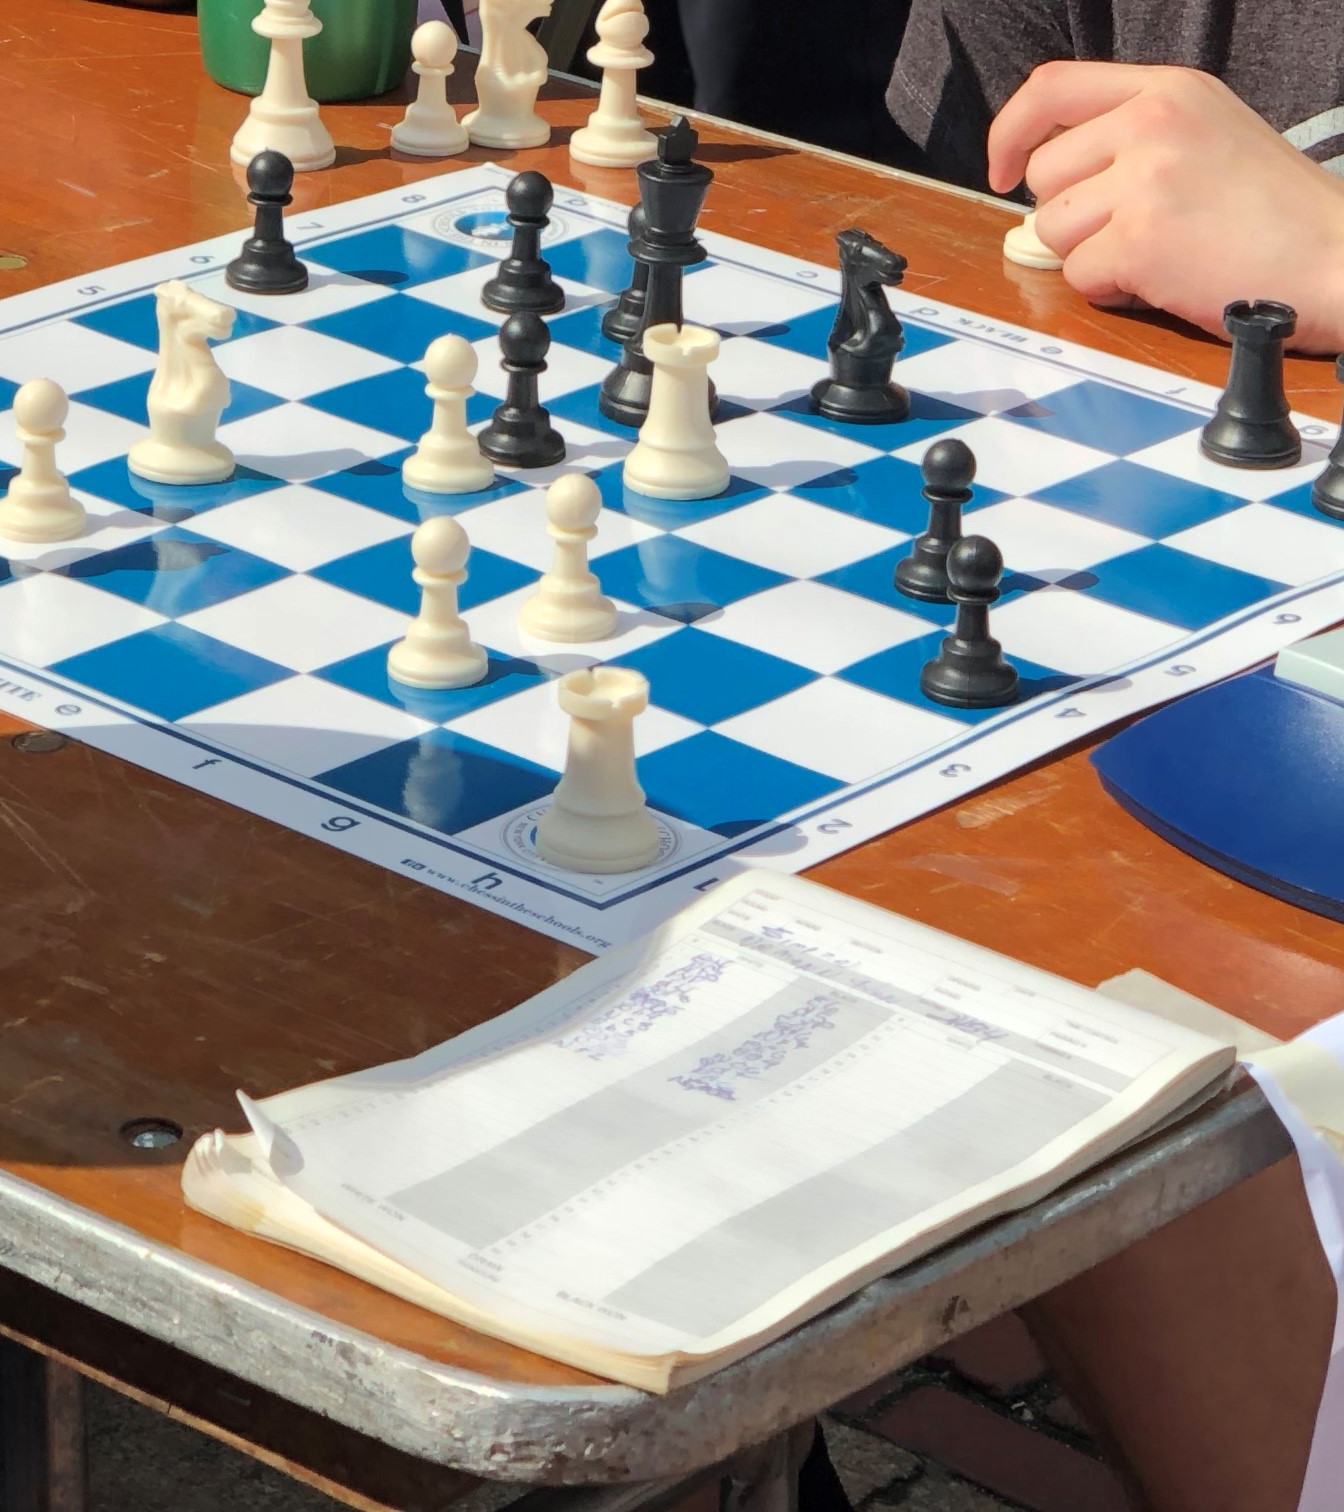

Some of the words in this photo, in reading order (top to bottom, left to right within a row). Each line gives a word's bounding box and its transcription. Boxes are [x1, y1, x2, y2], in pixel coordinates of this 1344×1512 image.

[952, 317, 1029, 344] BLACK
[1164, 664, 1197, 678] 5
[55, 703, 83, 717] e
[192, 757, 224, 771] f
[938, 762, 972, 778] 3
[321, 815, 362, 833] g
[816, 818, 854, 836] 2
[472, 871, 504, 892] h
[427, 867, 613, 949] www.chessintheschools.org
